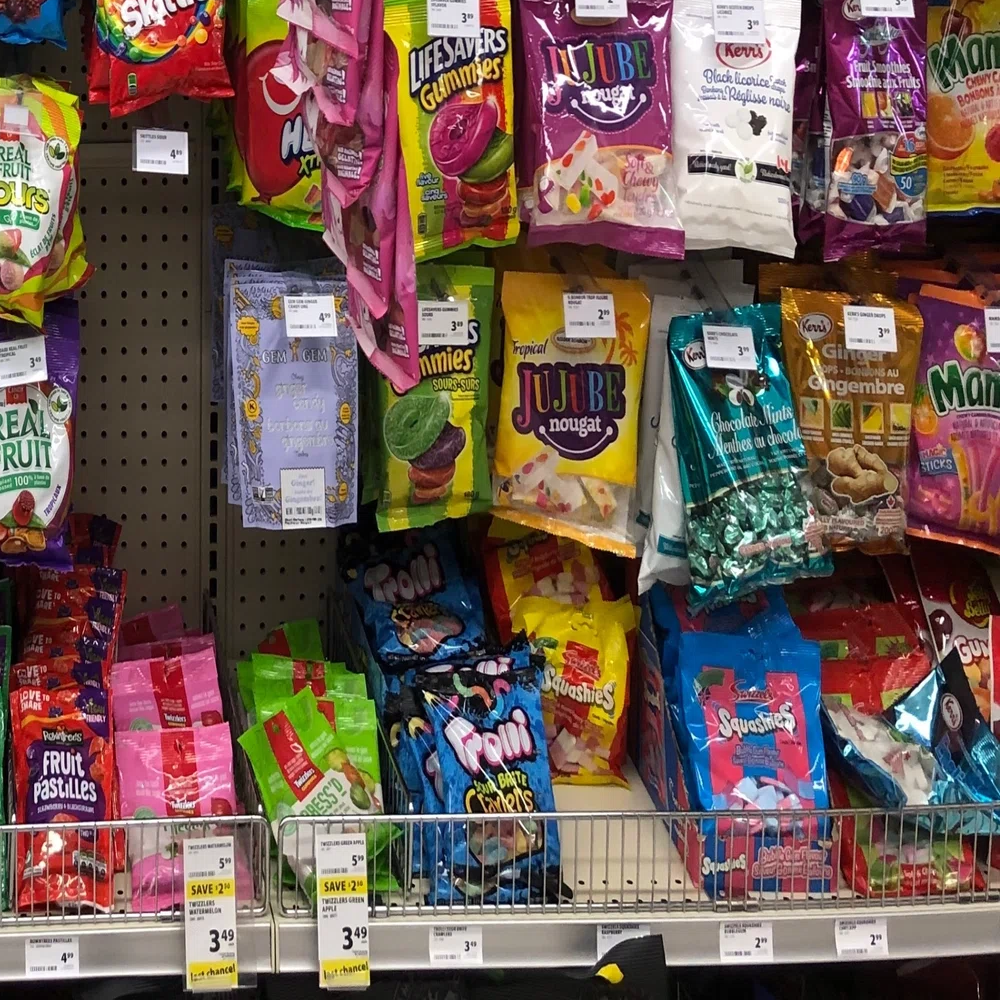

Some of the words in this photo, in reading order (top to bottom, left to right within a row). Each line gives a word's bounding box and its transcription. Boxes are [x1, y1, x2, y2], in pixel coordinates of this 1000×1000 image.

[420, 58, 502, 110] Gummies
[703, 69, 733, 84] Black
[735, 71, 769, 88] licorice
[769, 97, 790, 113] noire
[262, 351, 287, 363] GEM
[302, 350, 327, 362] GEM
[512, 340, 548, 362] Tropical
[517, 368, 621, 427] JUJUBE
[549, 417, 602, 437] nougat
[542, 665, 616, 711] Squashies
[718, 702, 797, 739] Squashies
[498, 770, 529, 787] BRITE
[191, 883, 214, 895] SAVE
[324, 880, 346, 892] SAVE
[189, 907, 222, 915] WATERMELON
